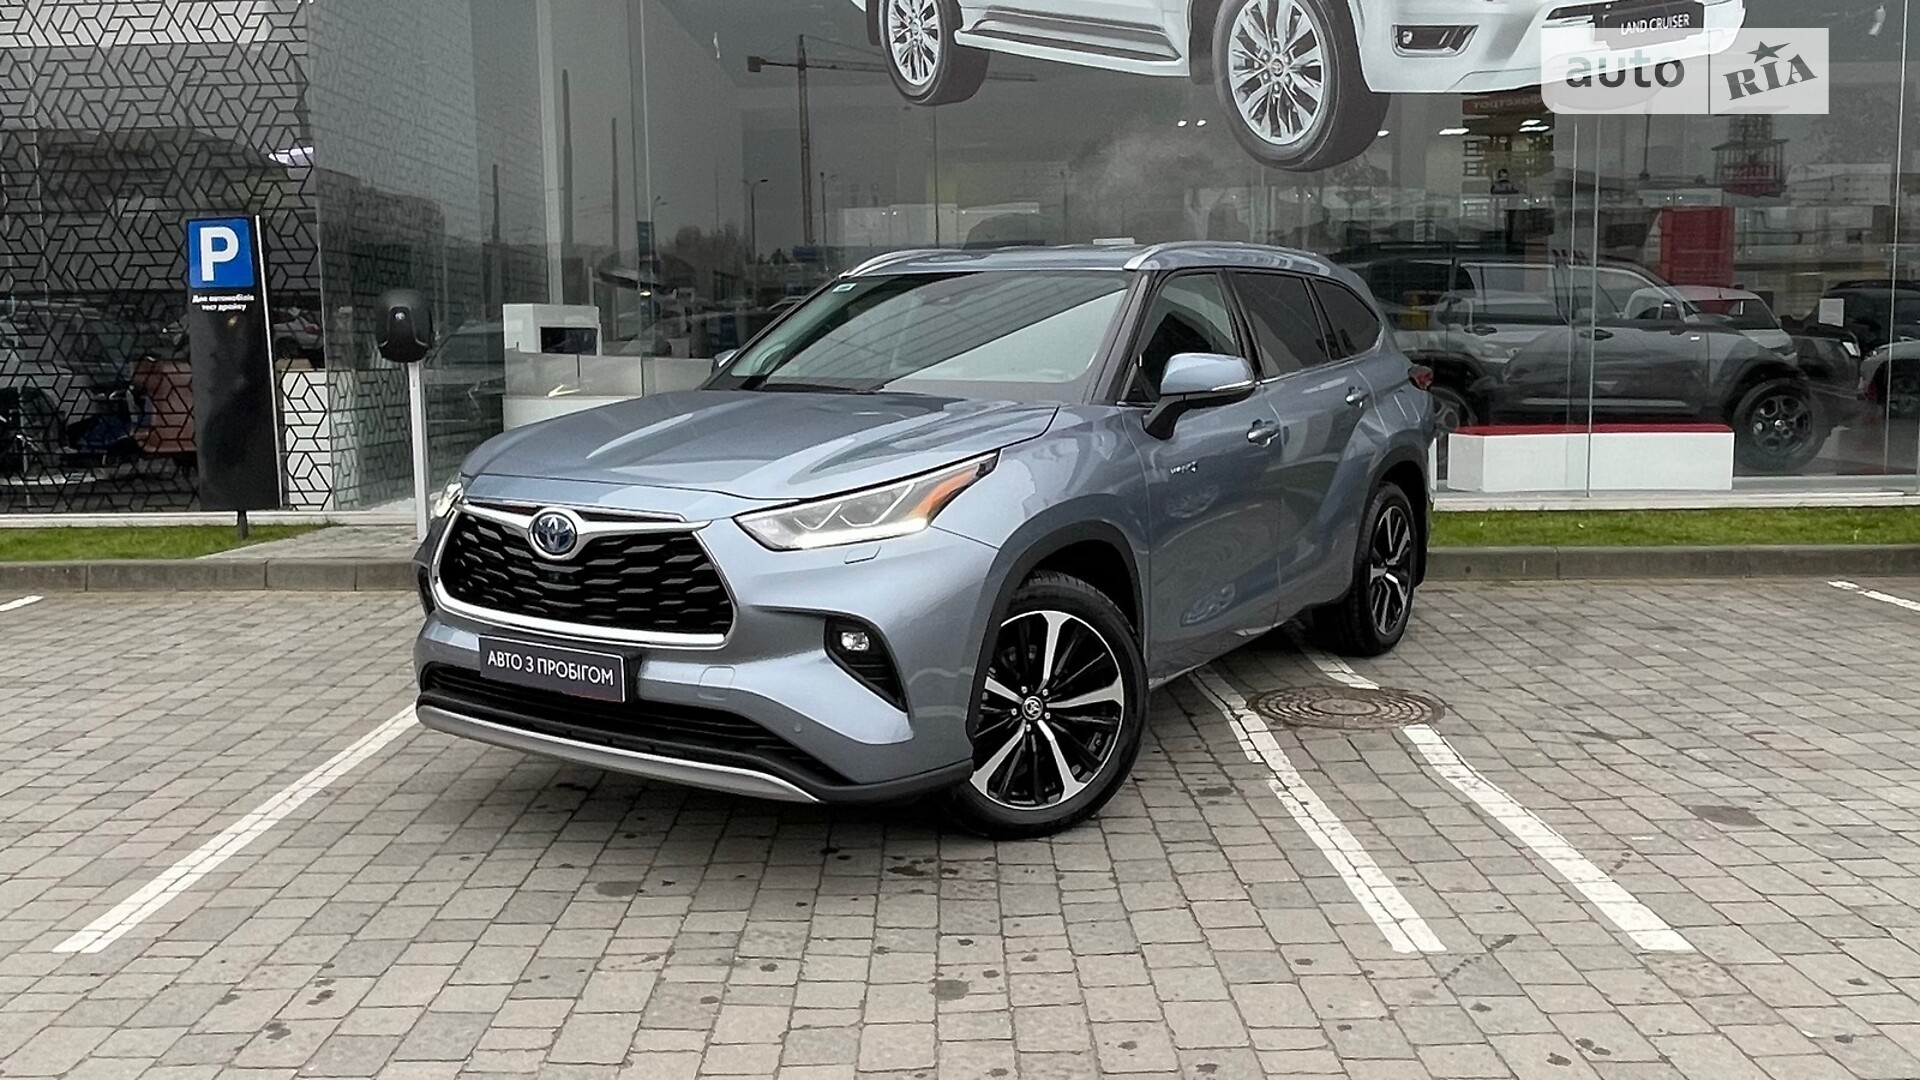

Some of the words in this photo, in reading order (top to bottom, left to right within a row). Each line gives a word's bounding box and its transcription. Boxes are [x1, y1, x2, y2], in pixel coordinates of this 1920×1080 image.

[1620, 19, 1648, 35] LAND
[1649, 13, 1691, 32] CRUISER
[200, 226, 239, 282] P
[487, 650, 523, 671] АВТО
[537, 657, 614, 686] ПРОБІГОМ
